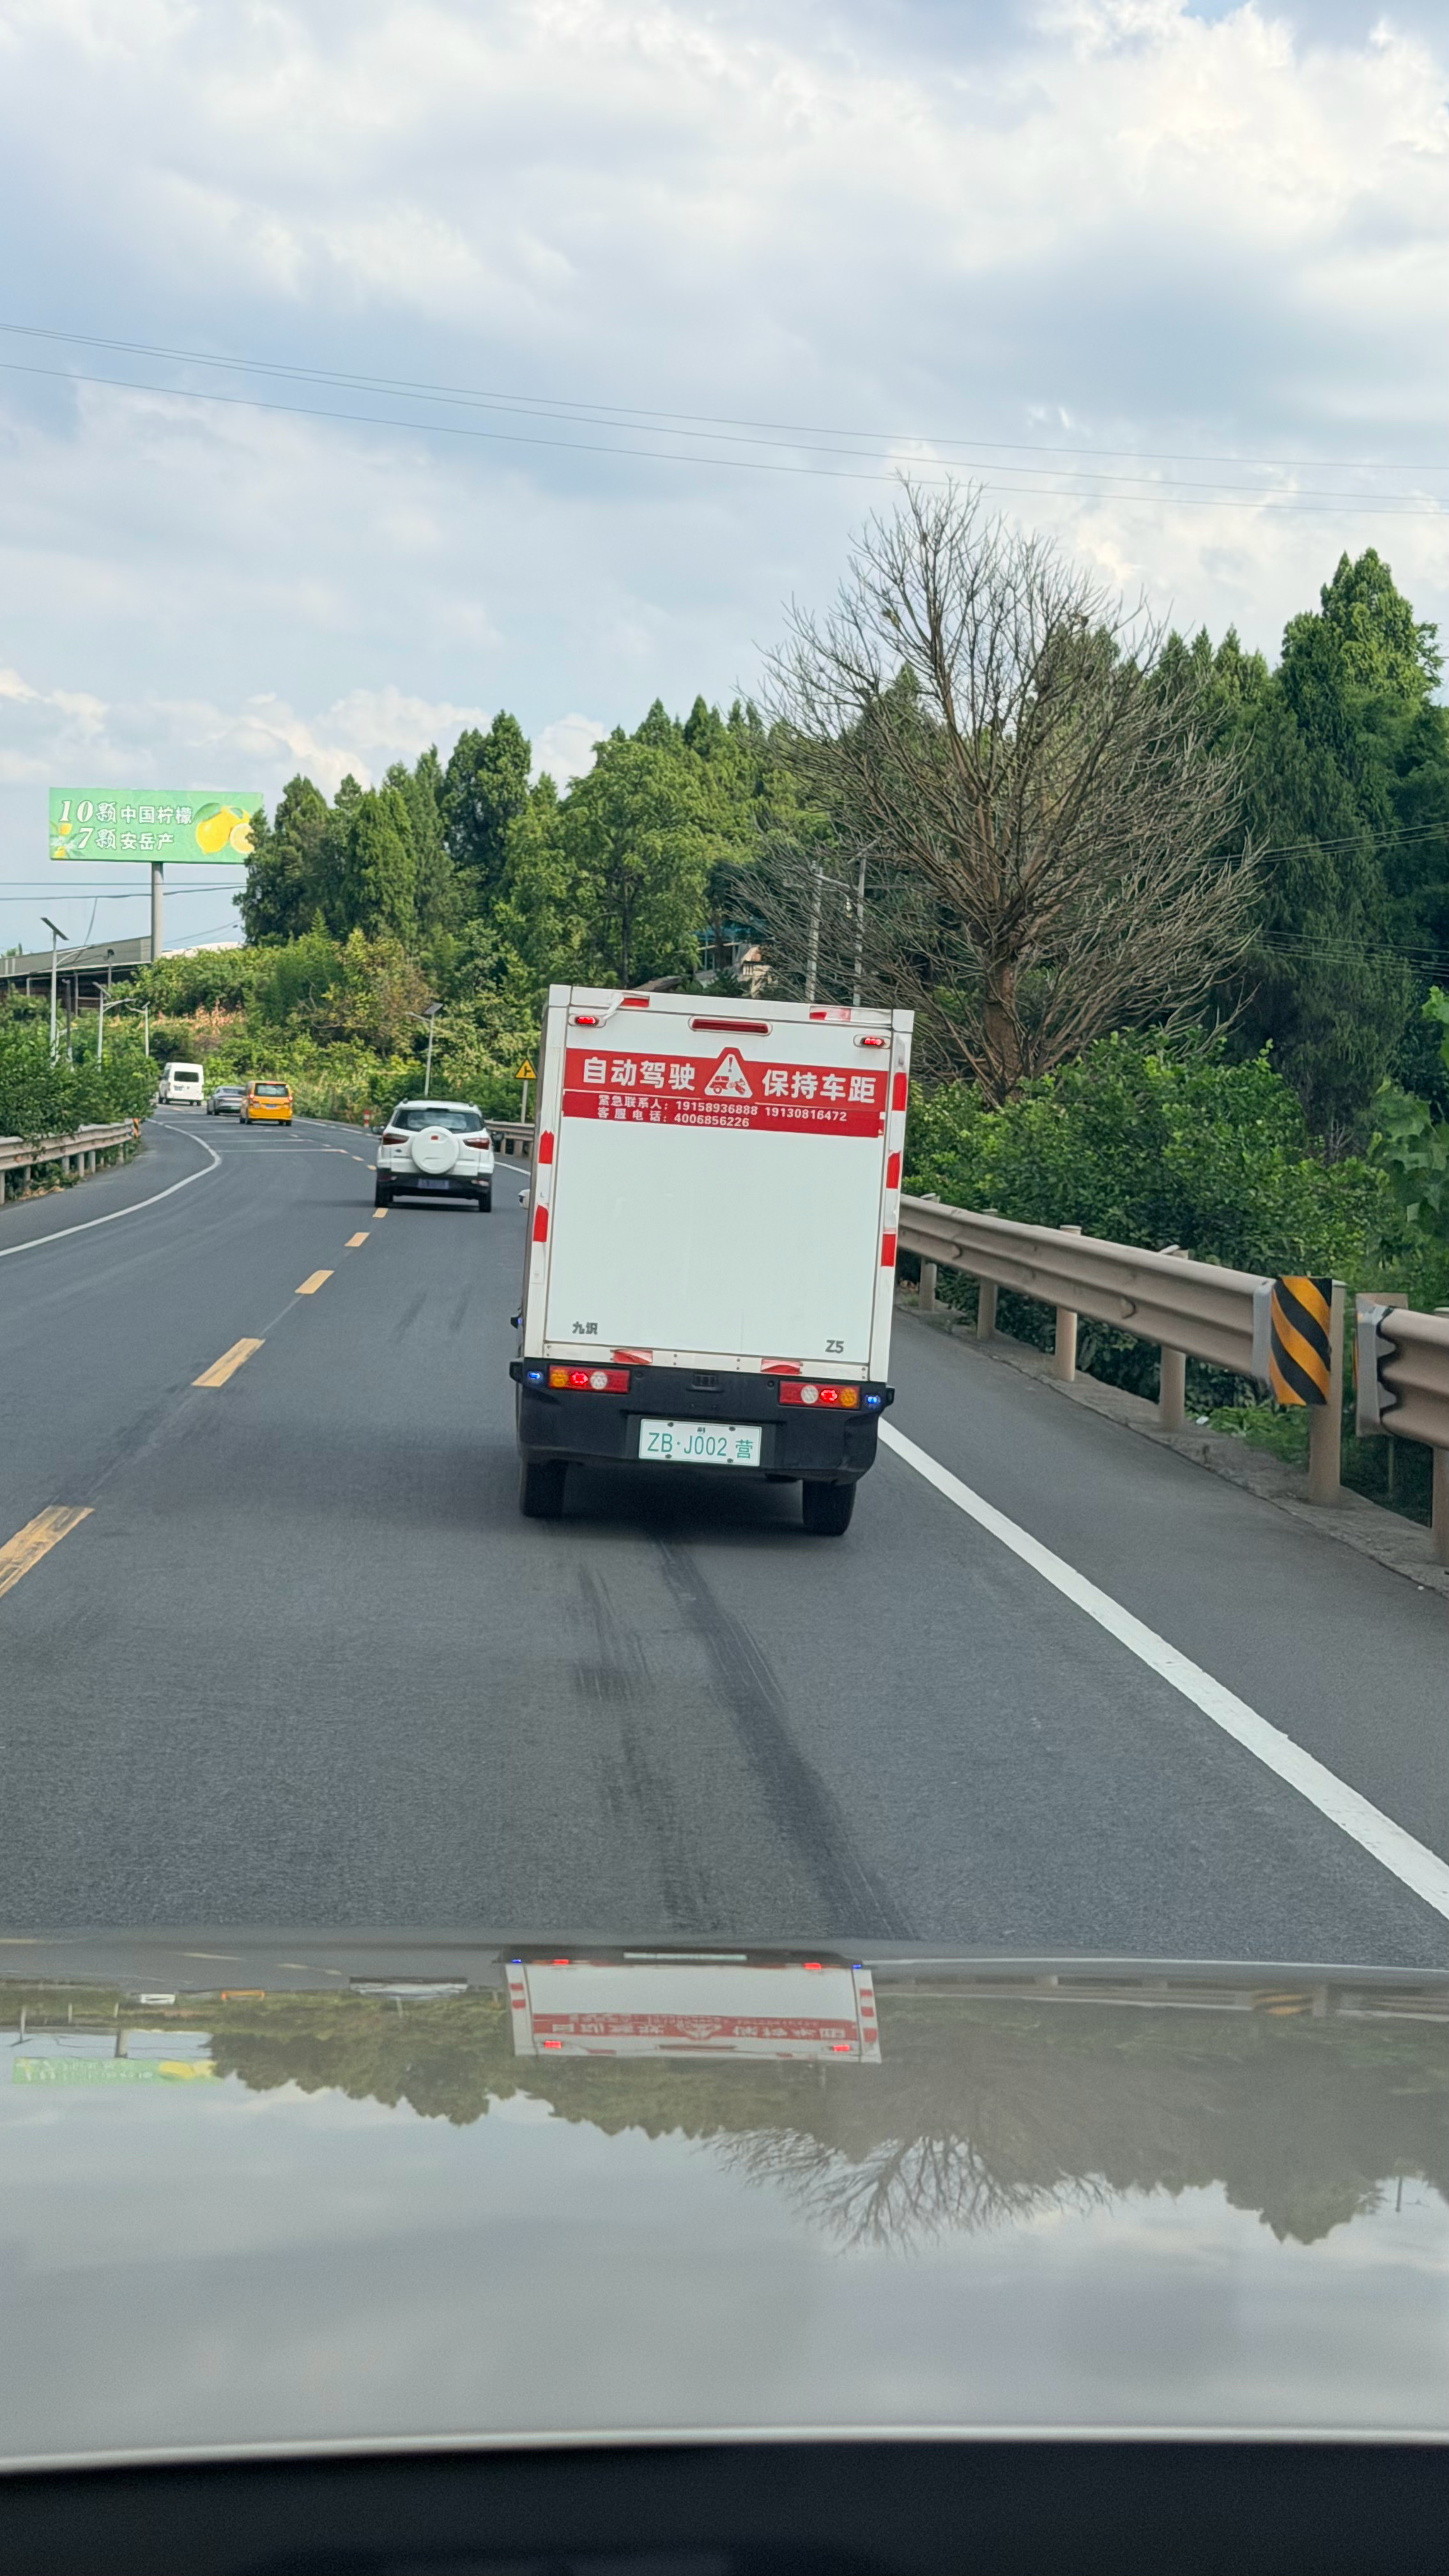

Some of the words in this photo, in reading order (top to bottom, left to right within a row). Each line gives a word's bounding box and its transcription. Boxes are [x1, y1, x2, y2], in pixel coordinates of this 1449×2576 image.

[583, 1056, 695, 1091] 自动驾驶
[762, 1069, 877, 1103] 保持车距
[673, 1113, 749, 1128] 4006856226
[675, 1101, 758, 1116] 19158936888
[765, 1107, 847, 1122] 19130816472
[825, 1339, 845, 1354] Z5
[647, 1432, 727, 1457] ZB·J002
[735, 1439, 753, 1459] 营
